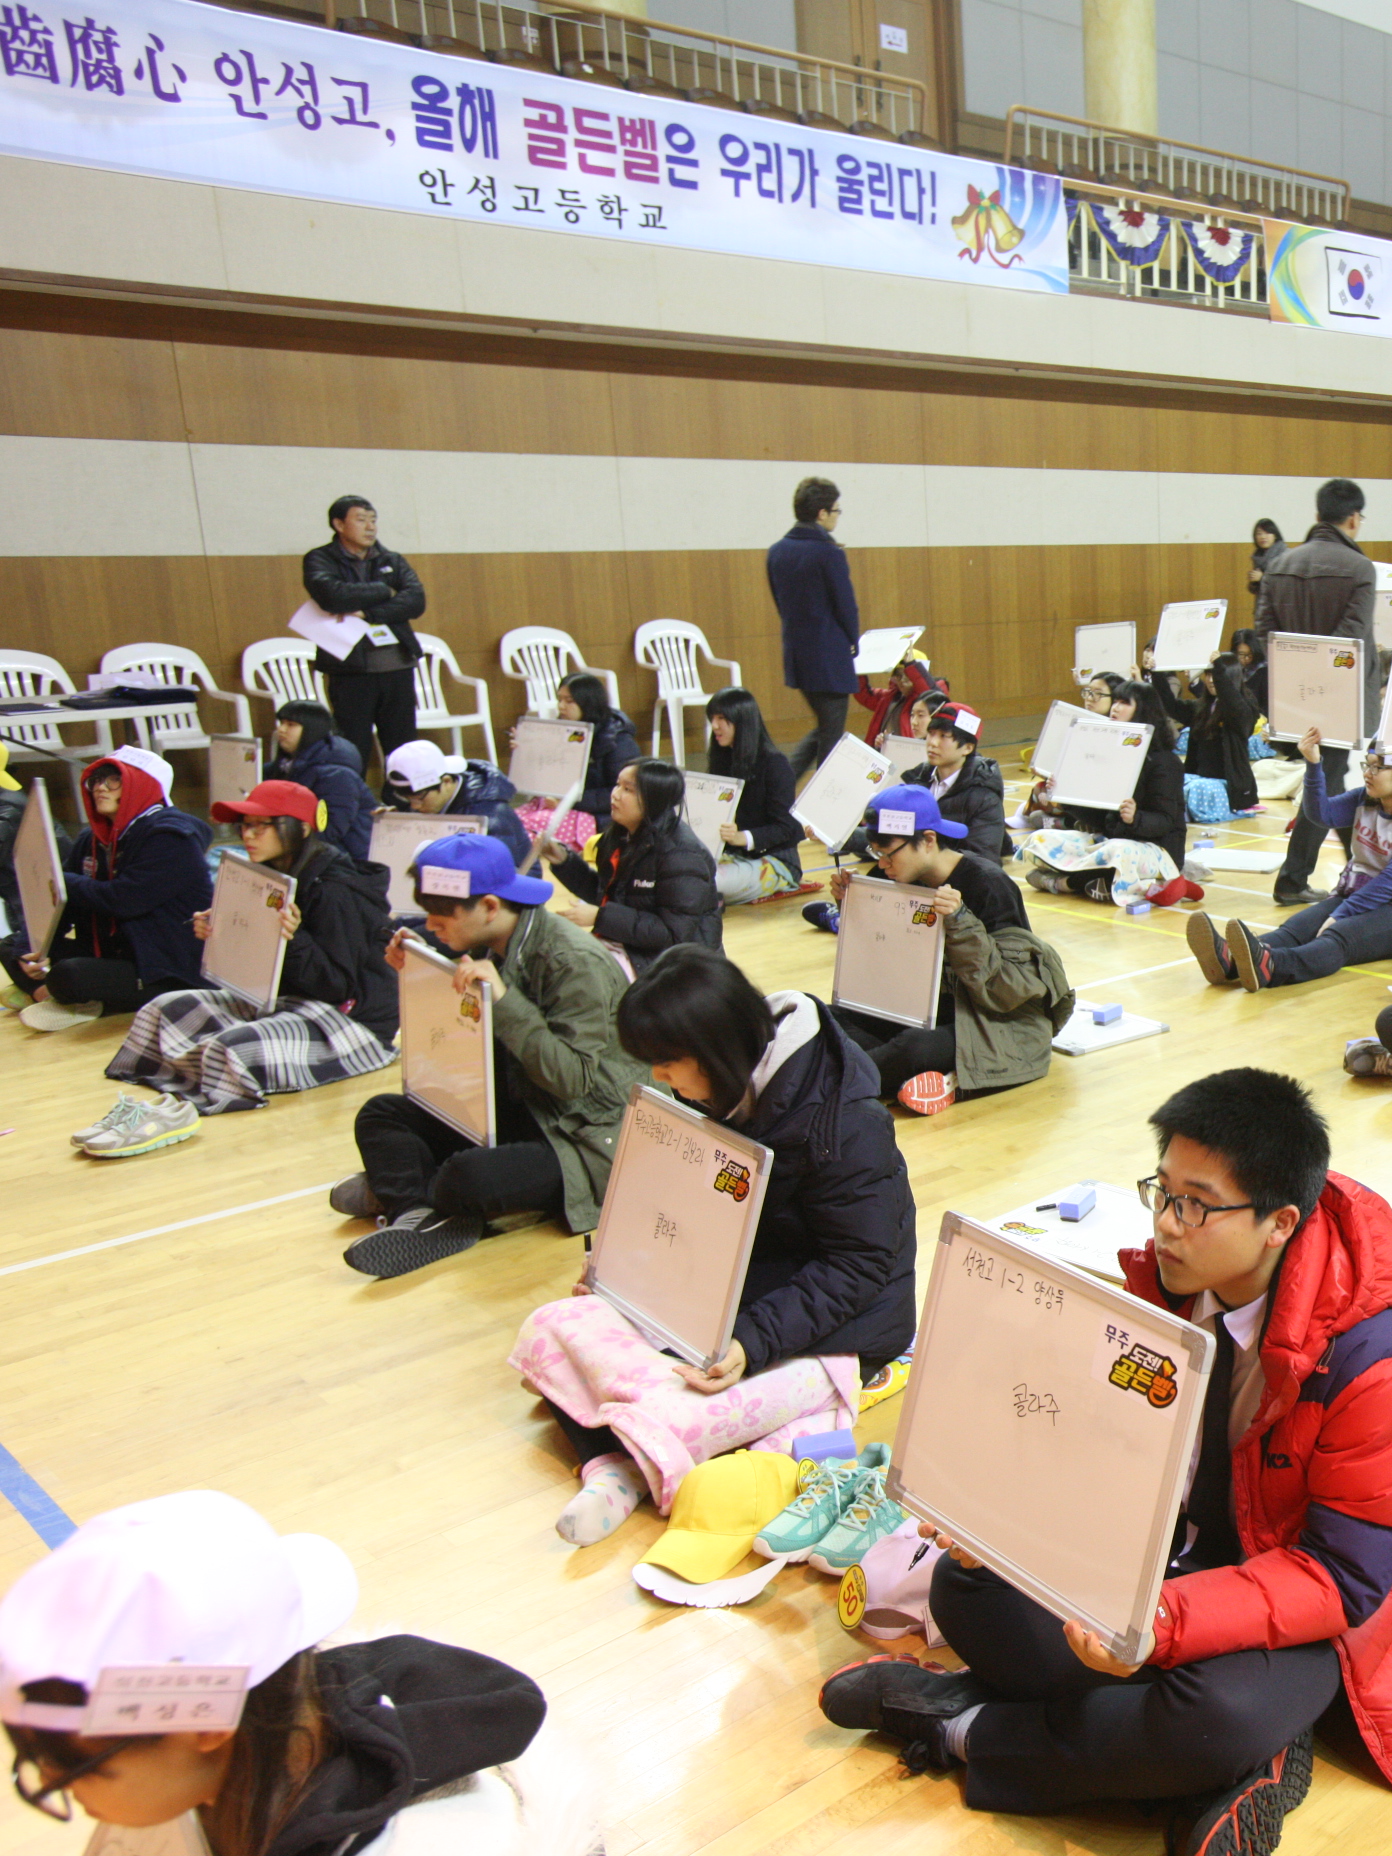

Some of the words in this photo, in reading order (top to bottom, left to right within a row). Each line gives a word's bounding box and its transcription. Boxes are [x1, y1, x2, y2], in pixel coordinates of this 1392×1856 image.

[214, 50, 396, 147] 안성고,
[411, 75, 499, 160] 올해
[522, 97, 699, 191] 골든벨은
[719, 133, 819, 208] 우리가
[836, 154, 938, 225] 울린다!
[418, 168, 667, 231] 안성고등학교
[713, 1149, 728, 1165] 무주
[715, 1170, 749, 1202] 골든벨
[653, 1212, 678, 1248] 콜라주
[962, 1247, 996, 1282] 설천고
[1000, 1267, 1025, 1294] 1-2
[1104, 1324, 1130, 1350] 무주
[1130, 1344, 1161, 1371] 도전!
[1110, 1356, 1177, 1407] 골든벨
[1012, 1382, 1061, 1427] 콜라주
[1266, 1452, 1294, 1469] K2
[842, 1582, 859, 1617] 50
